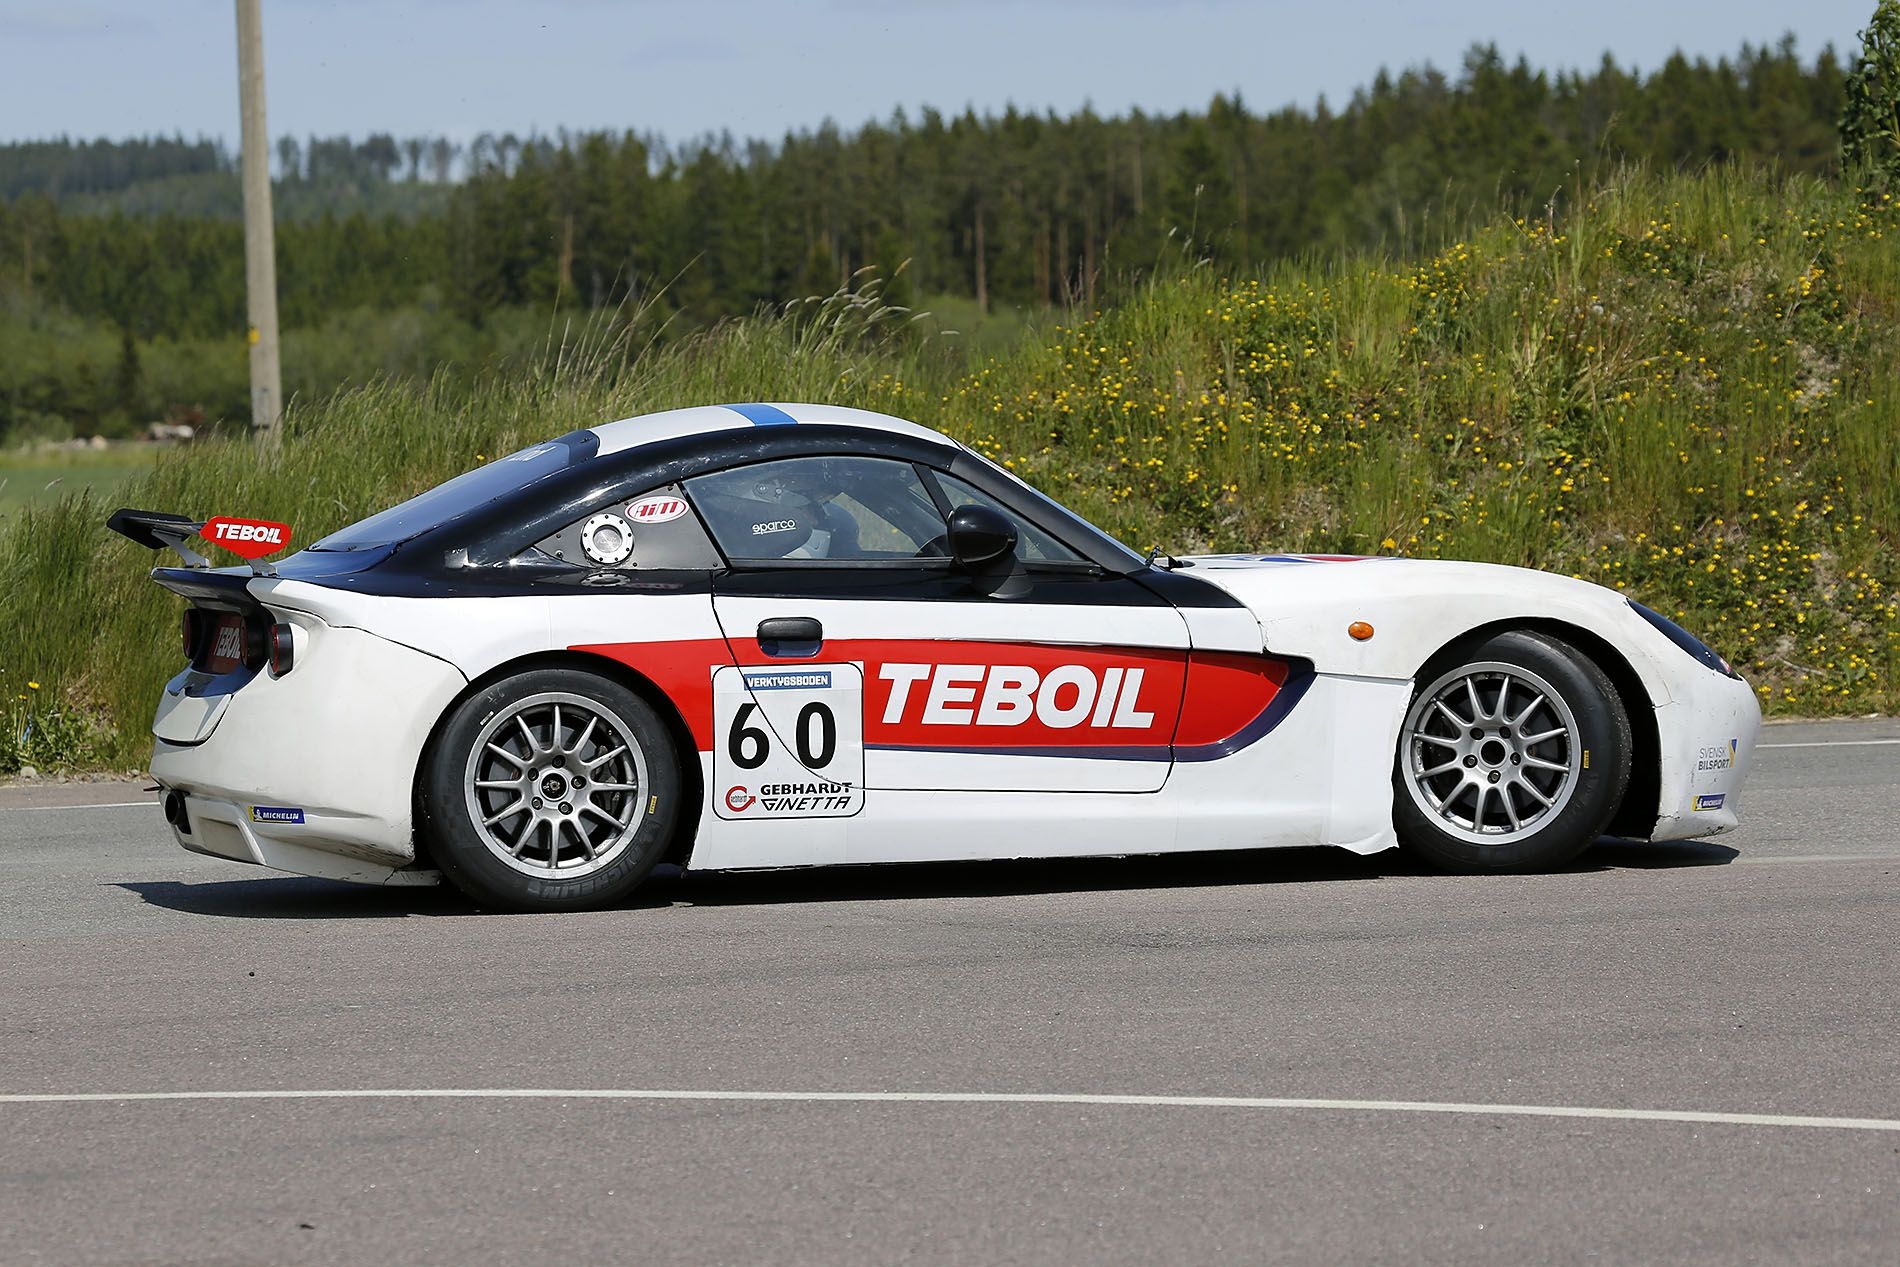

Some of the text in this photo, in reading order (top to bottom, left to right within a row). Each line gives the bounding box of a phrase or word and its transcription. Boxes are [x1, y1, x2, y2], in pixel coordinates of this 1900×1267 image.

[215, 523, 282, 544] TEBOIL
[747, 675, 829, 688] VERKTYGSBODEN
[878, 663, 1155, 728] TEBOIL
[728, 701, 837, 770] 60
[1699, 747, 1728, 759] SVENSK
[1698, 759, 1730, 770] BILSPORT
[760, 782, 853, 796] GEBHARDT
[760, 796, 852, 811] GINETTA
[262, 812, 299, 820] MICHELIN
